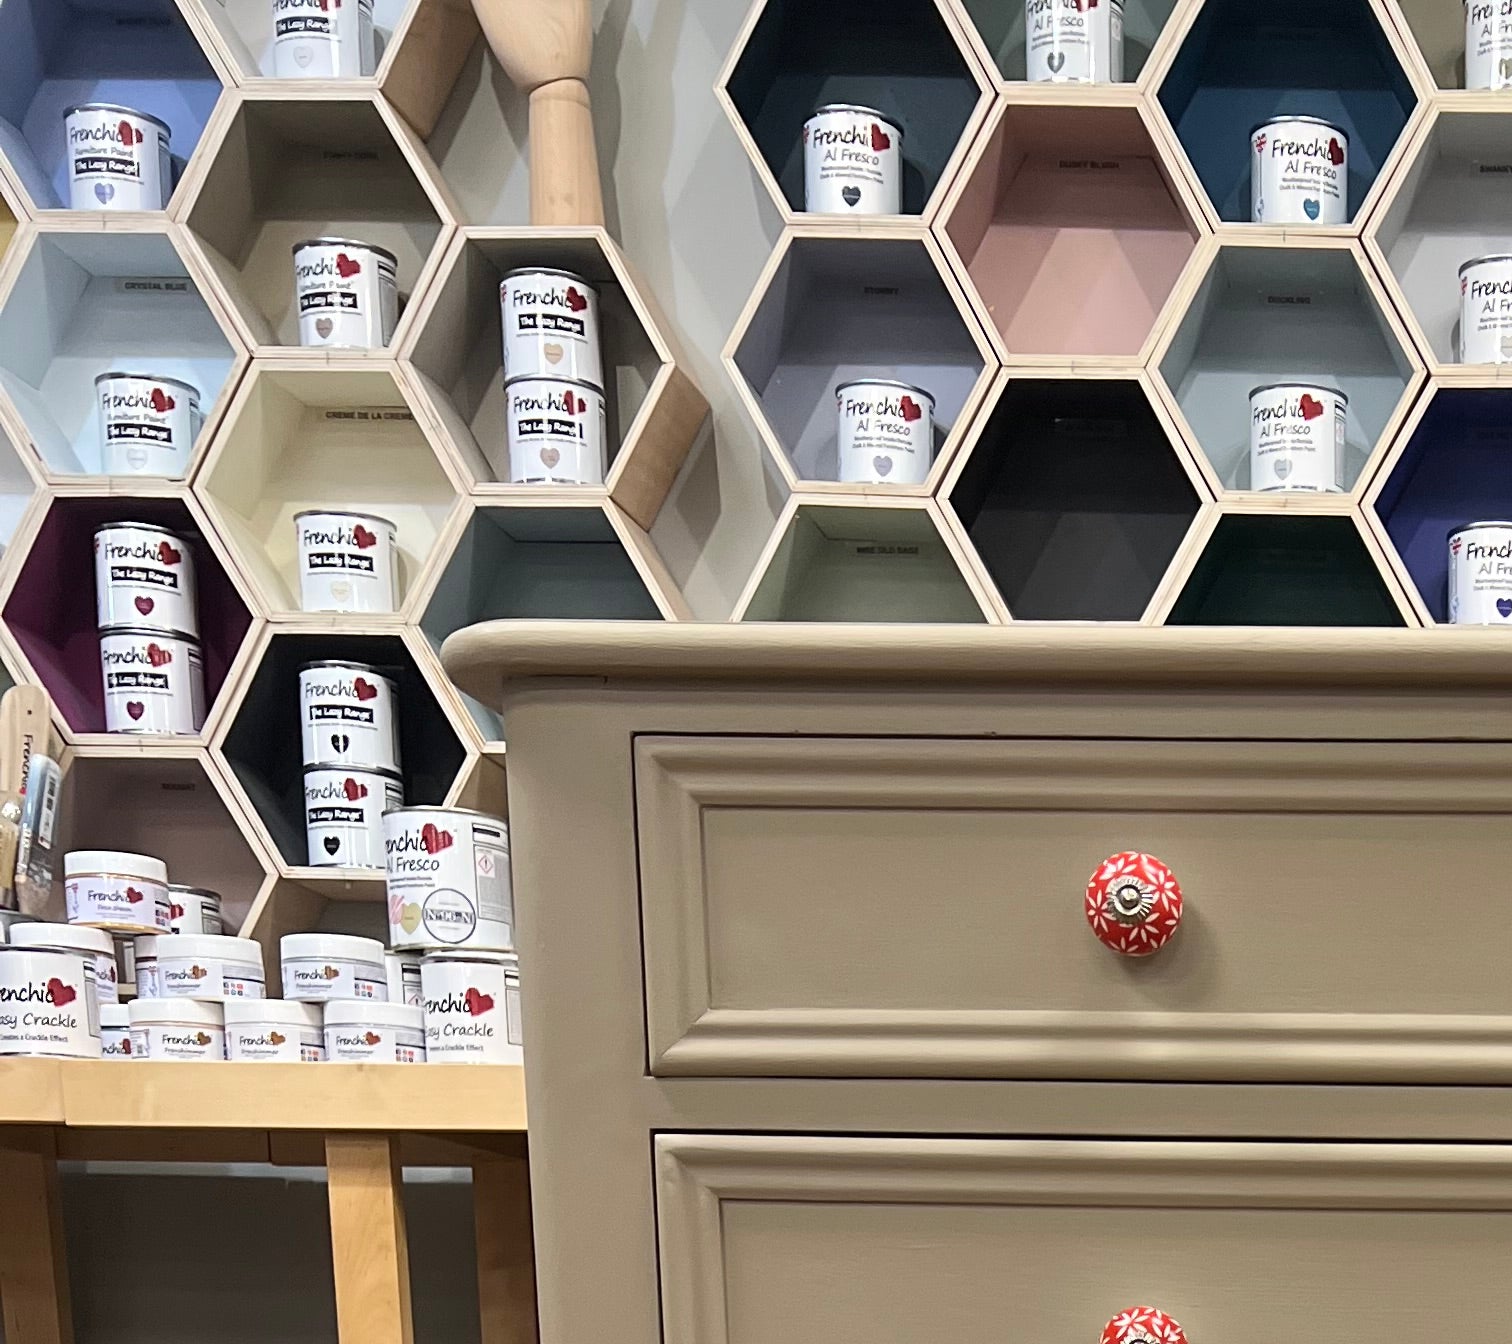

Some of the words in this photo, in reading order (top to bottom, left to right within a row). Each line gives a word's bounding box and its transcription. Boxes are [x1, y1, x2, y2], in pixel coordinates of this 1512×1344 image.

[824, 147, 837, 162] Al
[841, 148, 879, 166] Fresco
[1272, 138, 1333, 160] Frenchic
[1285, 159, 1300, 173] Al
[1303, 161, 1337, 180] Fresco
[1482, 298, 1496, 313] Al
[856, 418, 869, 432] Al
[874, 419, 911, 436] Fresco
[105, 542, 164, 562] Frenchic
[1479, 561, 1493, 575] Al
[396, 856, 440, 872] Fresco
[23, 1012, 78, 1029] Crackle
[444, 1022, 494, 1037] Crackle
